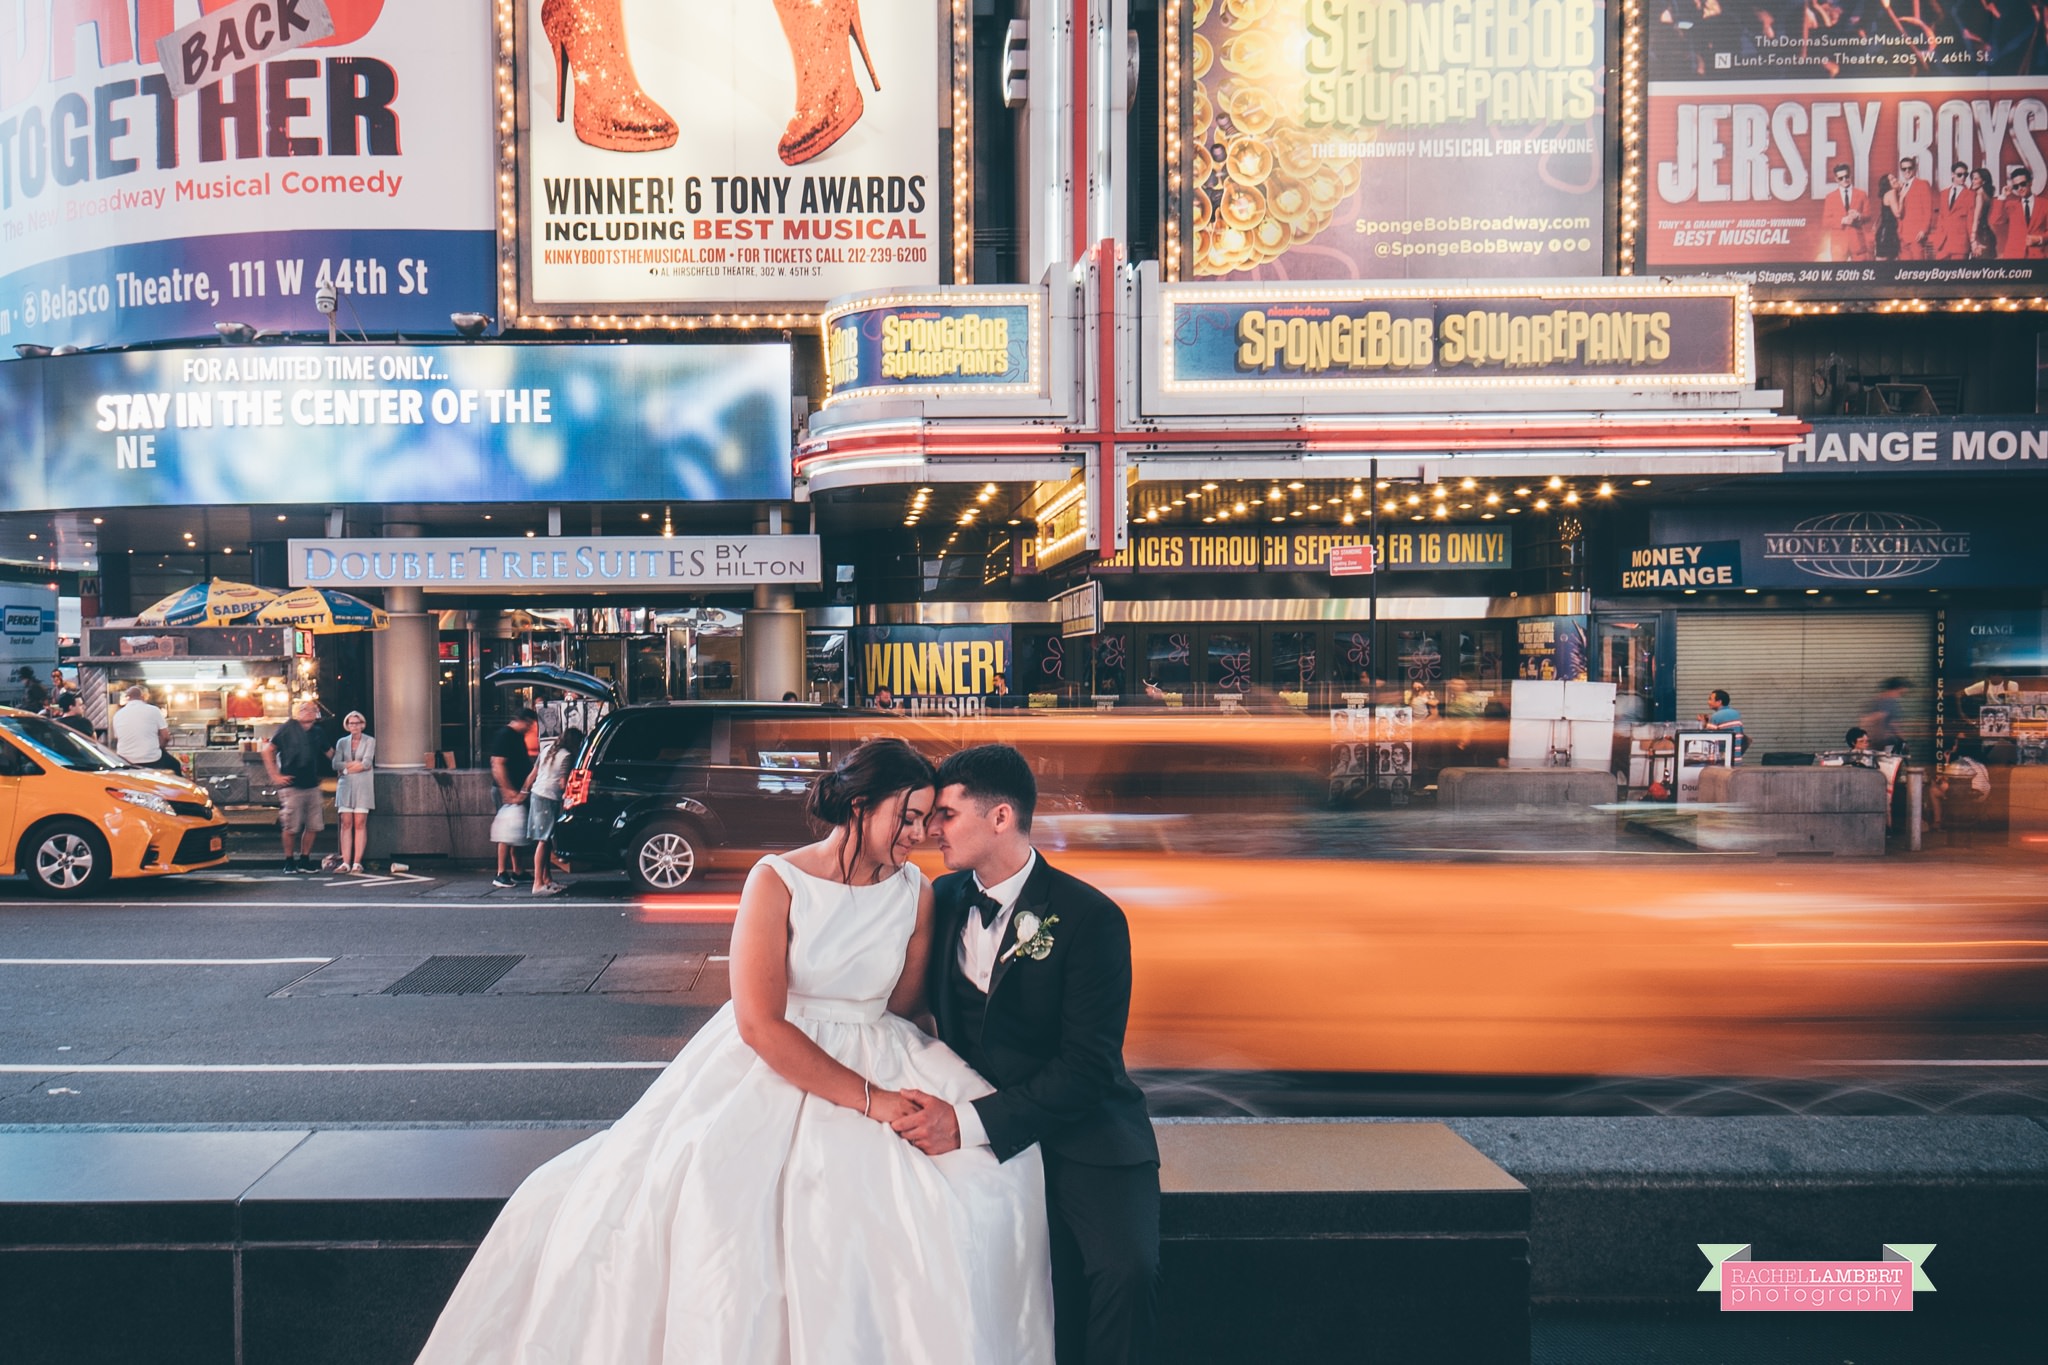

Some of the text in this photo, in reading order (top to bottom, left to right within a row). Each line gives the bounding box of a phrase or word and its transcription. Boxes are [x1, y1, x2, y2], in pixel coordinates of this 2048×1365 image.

[182, 0, 309, 86] BACK
[1305, 0, 1595, 74] SPONGEBOB
[1755, 34, 1954, 47] TheDonnaSummerMusical.com
[1833, 52, 1888, 66] Theatre,
[1893, 54, 1917, 66] 205
[1921, 52, 1938, 64] W.
[1942, 51, 1972, 64] 46th
[1976, 50, 1994, 63] St.
[1305, 68, 1595, 131] SQUAREPANTS
[0, 57, 403, 211] TOGETHER
[1311, 137, 1594, 158] THE BROADWAY MUSICAL FOR EVERYONE
[1657, 98, 2048, 204] JERSEY BOYS
[3, 170, 403, 243] The New Broadway Musical Comedy
[543, 175, 925, 215] WINNER! 6 TONY AWARDS
[545, 218, 926, 241] INCLUDING BEST MUSICAL
[1355, 217, 1590, 234] SpongeBobBroadway.com
[1737, 218, 1806, 228] AWARD-WINNING
[1374, 238, 1544, 258] @SpongeBobBway
[1673, 229, 1791, 247] BEST MUSICAL
[544, 247, 927, 265] KINKYBOOTSTHEMUSICAL.COM FOR TICKETS CALL 212-239-6200
[661, 266, 823, 278] AL HIRSCHFELD THEATRE, 302 W. 45TH ST.
[1757, 271, 1796, 283] Stages,
[1798, 270, 1819, 281] 340
[1821, 270, 1833, 281] W.
[1835, 269, 1860, 281] 50th
[1862, 268, 1876, 280] St.
[1895, 268, 2032, 281] JerseyBoysNewYork.com
[41, 283, 110, 323] Belasco
[116, 268, 219, 308] Theatre,
[230, 263, 266, 298] 111
[277, 260, 303, 296] W
[315, 259, 387, 294] 44th
[399, 259, 429, 295] St
[1267, 306, 1330, 317] nickelodeon
[882, 314, 1009, 353] SPONGEBOB
[1238, 309, 1671, 372] SPONGEBOB SQUAREPANTS
[183, 355, 449, 382] FOR A LIMITED TIME ONLY...
[882, 349, 1009, 380] SQUAREPANTS
[96, 388, 552, 432] STAY IN THE CENTER OF THE
[116, 435, 156, 469] NE
[716, 544, 748, 559] BY
[1190, 536, 1288, 566] THROUGH
[1419, 534, 1440, 563] 16
[1447, 534, 1503, 563] ONLY!
[1632, 546, 1702, 567] MONEY
[1766, 537, 1970, 553] MONEY EXCHANGE
[716, 561, 804, 576] HILTON
[1622, 566, 1733, 588] EXCHANGE
[7, 615, 39, 625] PENSKE
[1937, 611, 1945, 669] MONEY
[865, 640, 1004, 696] WINNER!
[1936, 678, 1945, 773] EXCHANGE
